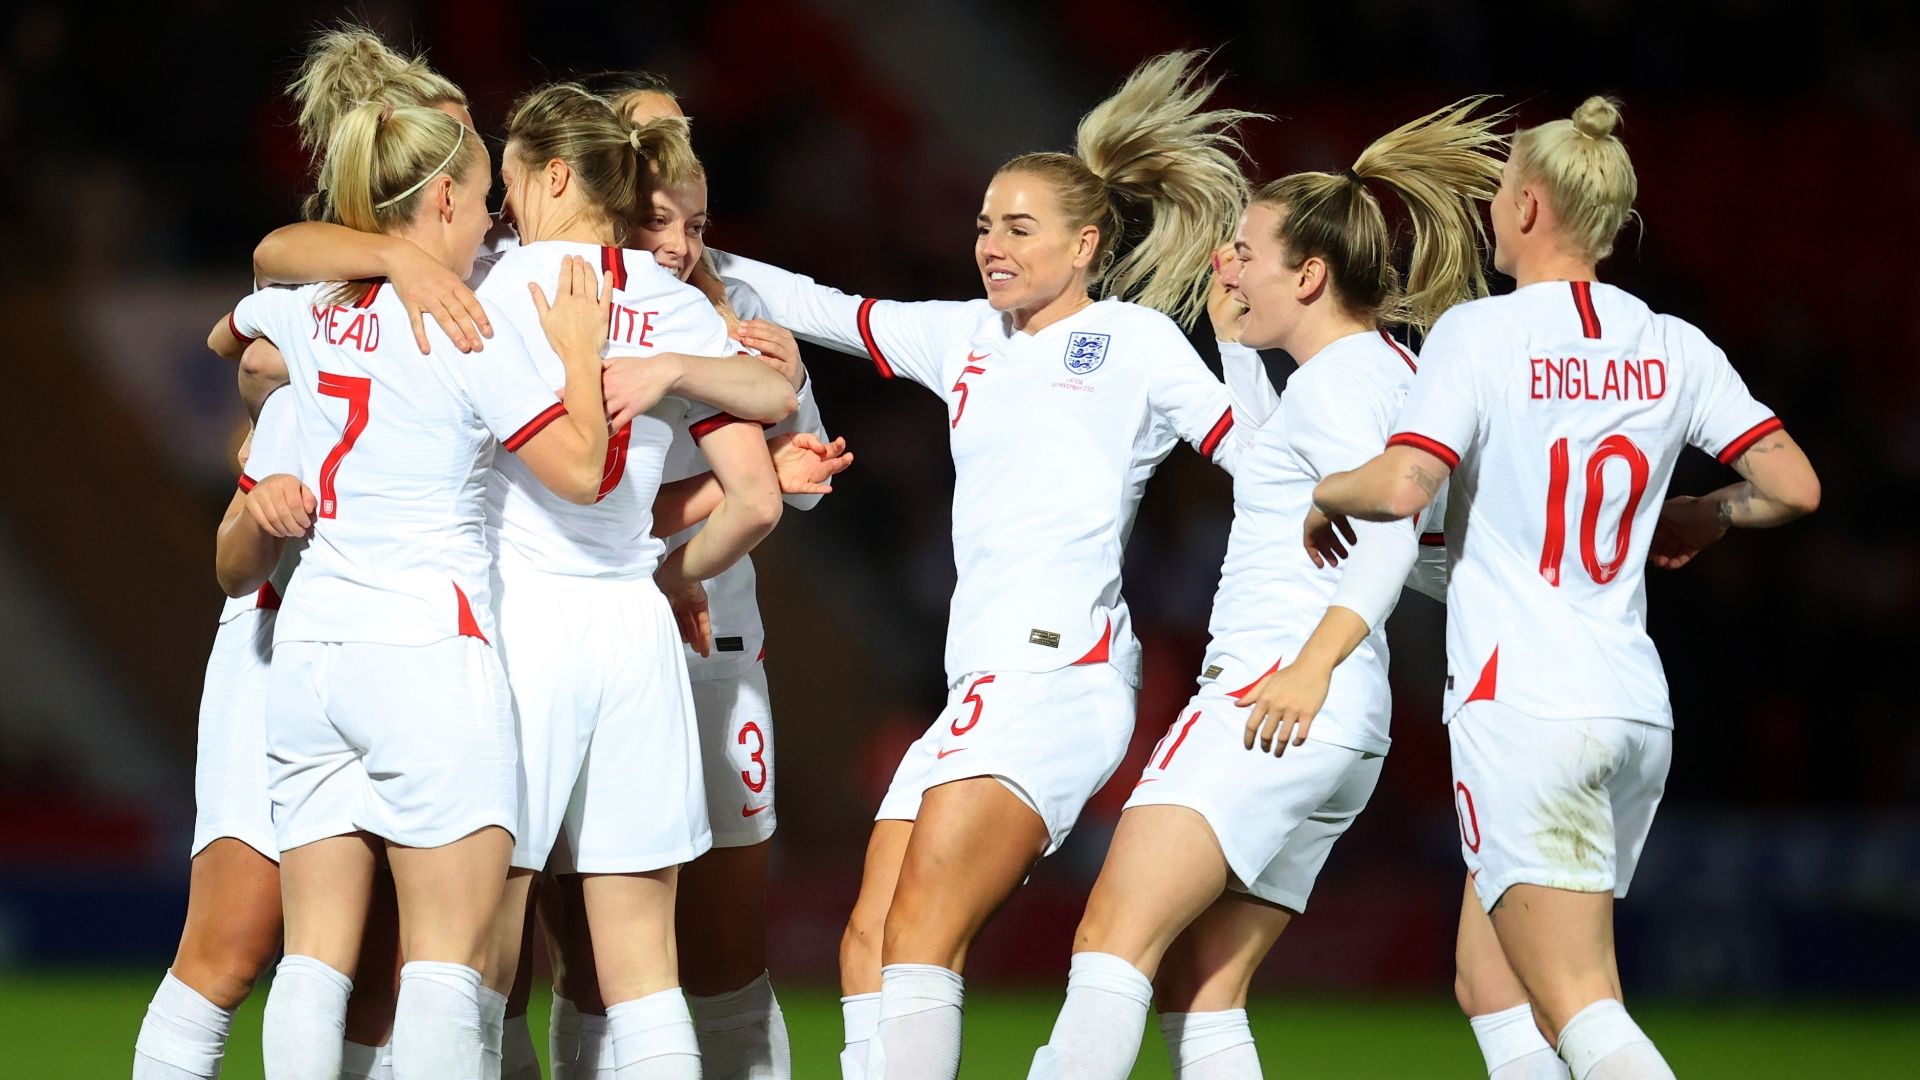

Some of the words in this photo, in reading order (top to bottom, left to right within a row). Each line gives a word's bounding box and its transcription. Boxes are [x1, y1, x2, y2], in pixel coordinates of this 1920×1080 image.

[311, 303, 380, 353] MEAD
[607, 302, 659, 348] ITE
[951, 365, 987, 430] 5
[1530, 357, 1667, 401] ENGLAND
[317, 370, 371, 519] 7
[1538, 434, 1650, 588] 10
[950, 675, 996, 737] 5
[738, 721, 768, 794] 3
[1456, 780, 1481, 855] 0
